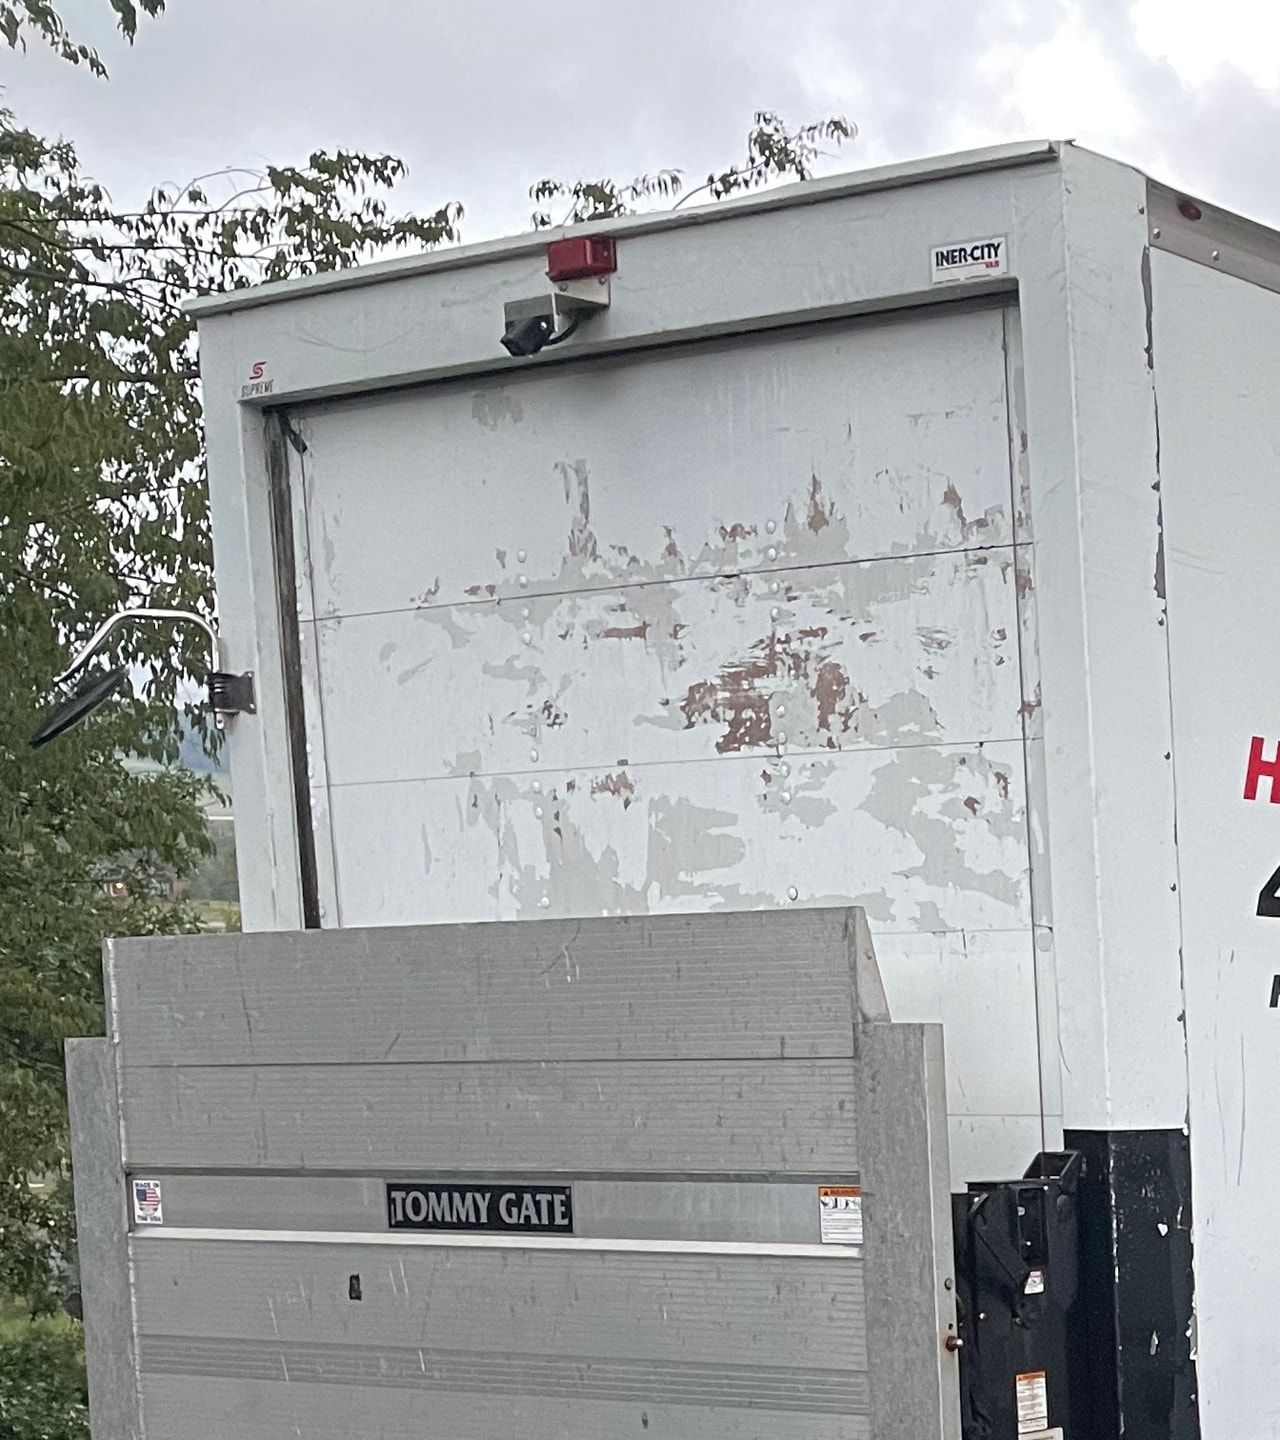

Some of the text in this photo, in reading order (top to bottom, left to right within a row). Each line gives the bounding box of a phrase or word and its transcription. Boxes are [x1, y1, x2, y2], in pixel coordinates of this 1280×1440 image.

[936, 242, 1003, 267] INER-CITY
[391, 1190, 569, 1226] TOMMY GATE
